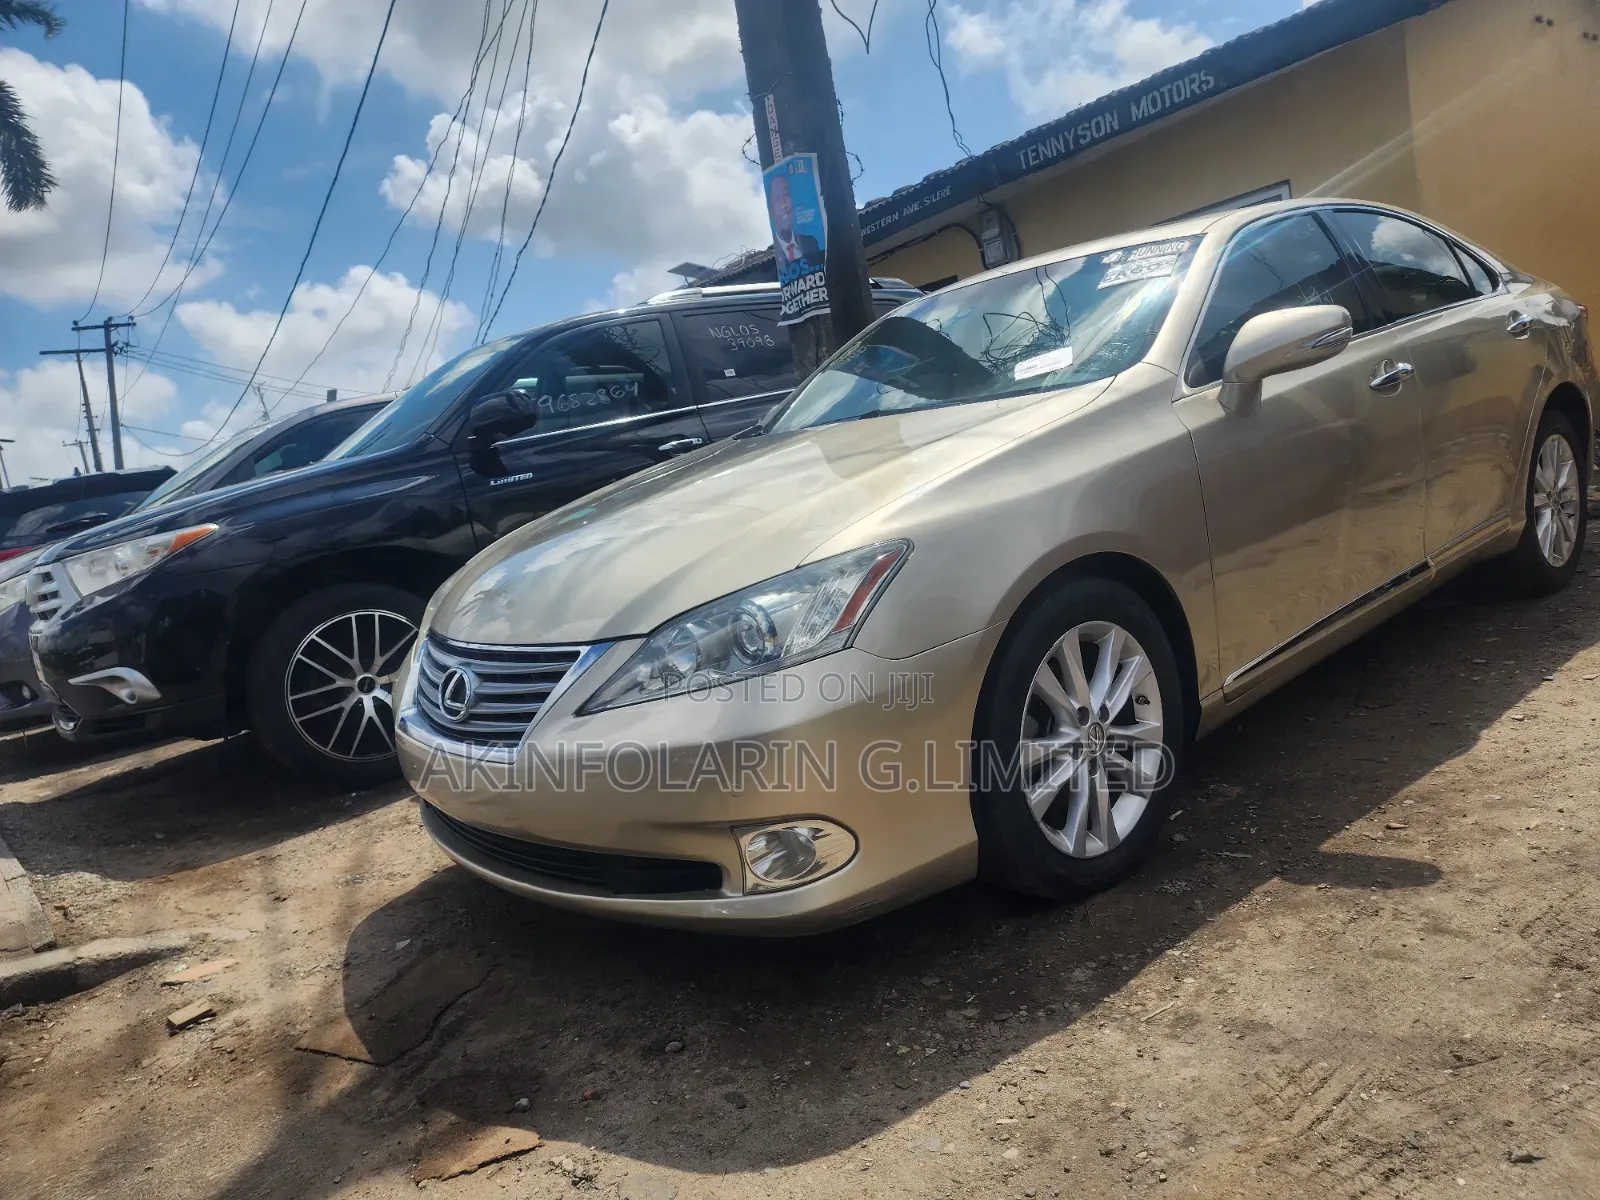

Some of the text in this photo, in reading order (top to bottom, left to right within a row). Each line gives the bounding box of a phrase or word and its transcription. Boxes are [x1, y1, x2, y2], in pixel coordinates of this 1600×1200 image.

[1016, 69, 1215, 170] TENNYSON MOTORS
[859, 211, 899, 238] WESTERN
[707, 324, 760, 339] NGLOS
[727, 334, 775, 351] 39098
[537, 381, 639, 414] 9682864
